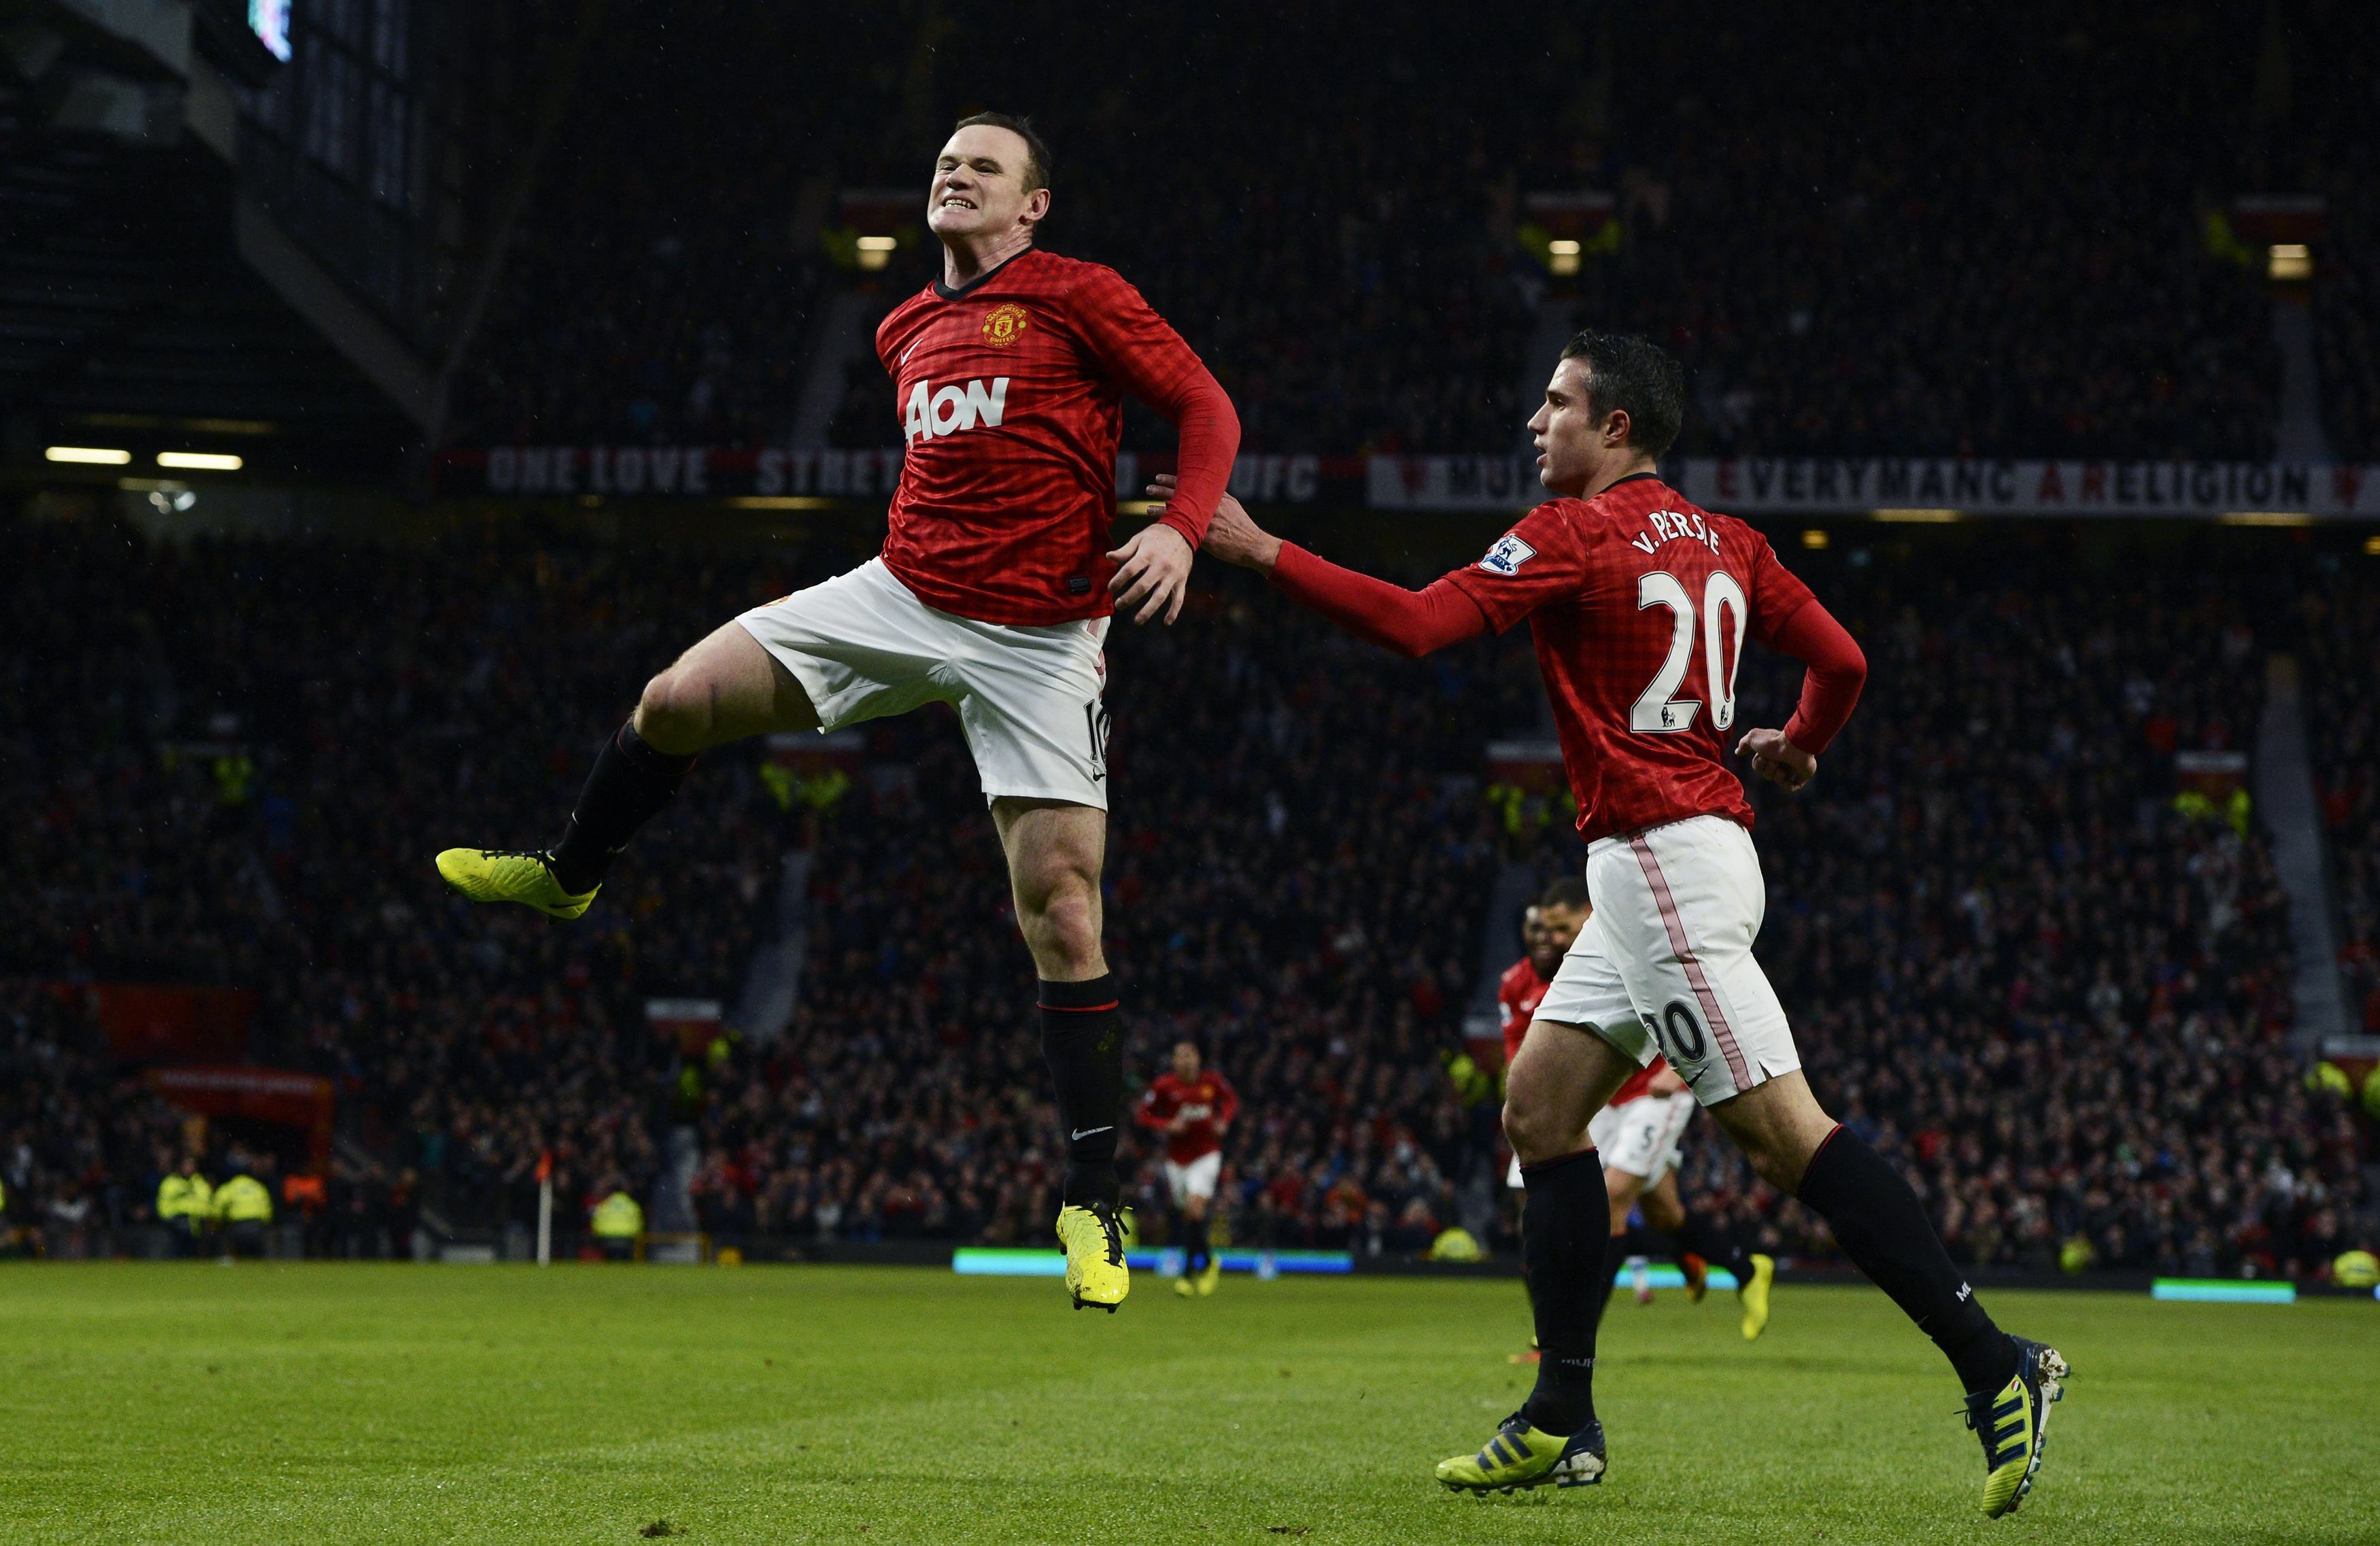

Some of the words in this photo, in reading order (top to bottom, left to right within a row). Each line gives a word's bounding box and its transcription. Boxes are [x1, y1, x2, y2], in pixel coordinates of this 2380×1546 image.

[989, 334, 1015, 343] UNITED
[905, 377, 1010, 451] AON
[487, 446, 576, 494] ONE
[590, 446, 708, 495] LOVE
[755, 447, 904, 496] STRET
[2037, 462, 2064, 504] A
[2079, 462, 2309, 505] RELIGION
[1631, 570, 1748, 733] 20
